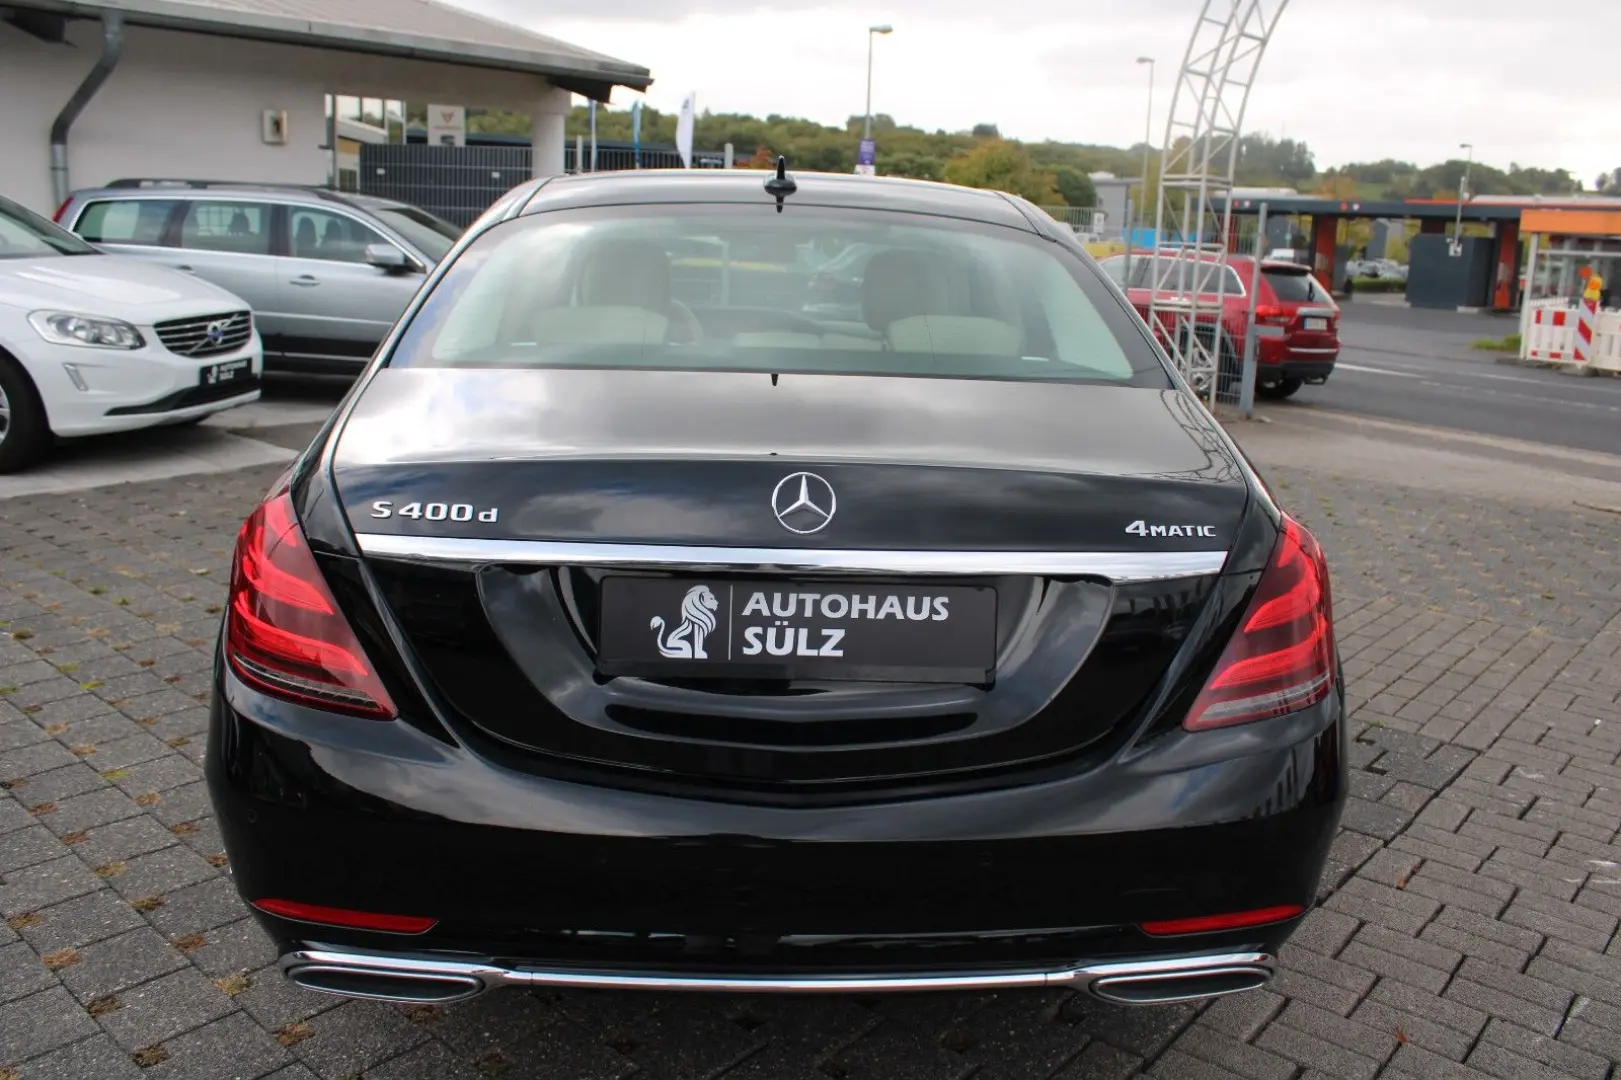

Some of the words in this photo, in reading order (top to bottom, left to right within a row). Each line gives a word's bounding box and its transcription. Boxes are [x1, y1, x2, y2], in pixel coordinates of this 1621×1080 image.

[1124, 520, 1217, 537] 4MATIC
[741, 592, 949, 621] AUTOHAUS
[742, 620, 846, 657] SÜLZ
